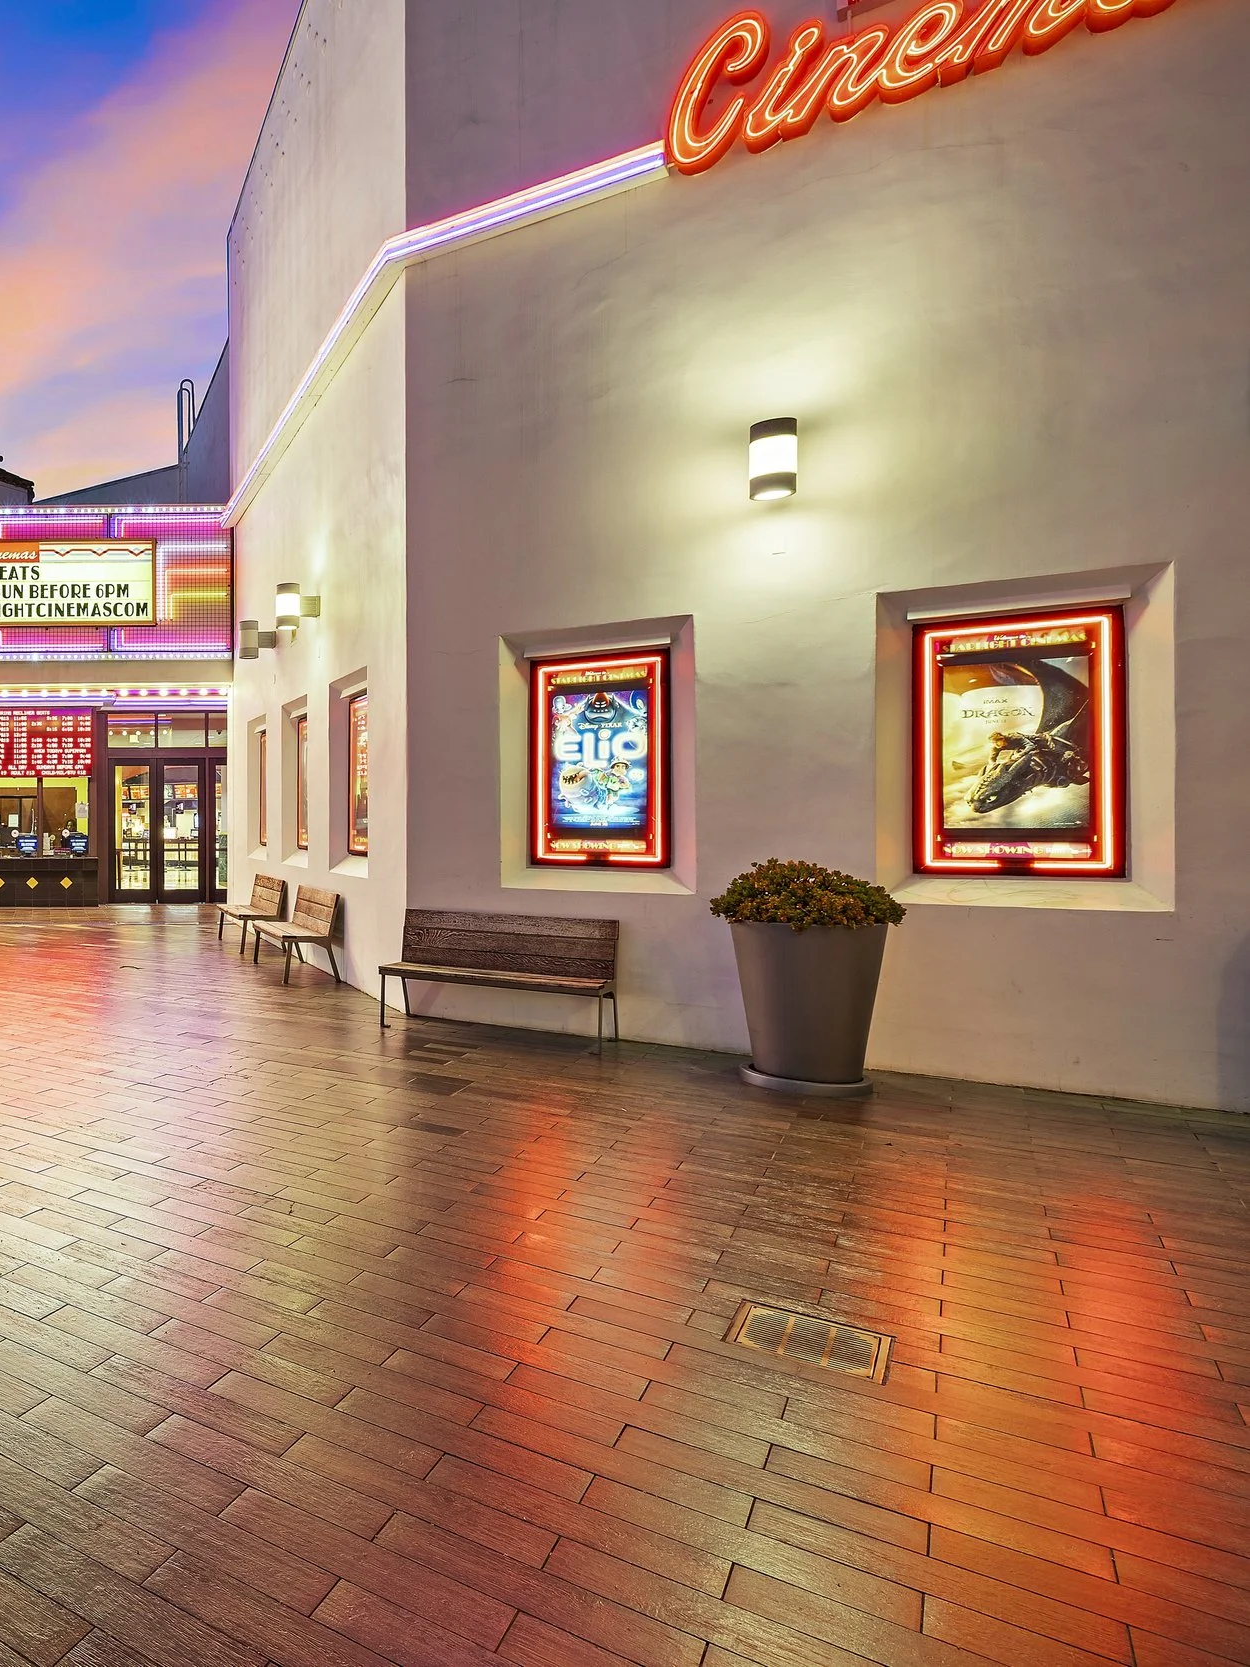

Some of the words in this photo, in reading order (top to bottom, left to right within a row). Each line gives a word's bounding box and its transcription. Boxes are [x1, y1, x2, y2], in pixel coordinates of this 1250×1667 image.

[668, 0, 1178, 176] Cinem
[29, 583, 91, 599] BEFORE
[95, 583, 129, 599] 6PM
[961, 707, 1036, 719] DRAGON
[578, 722, 599, 730] Disney
